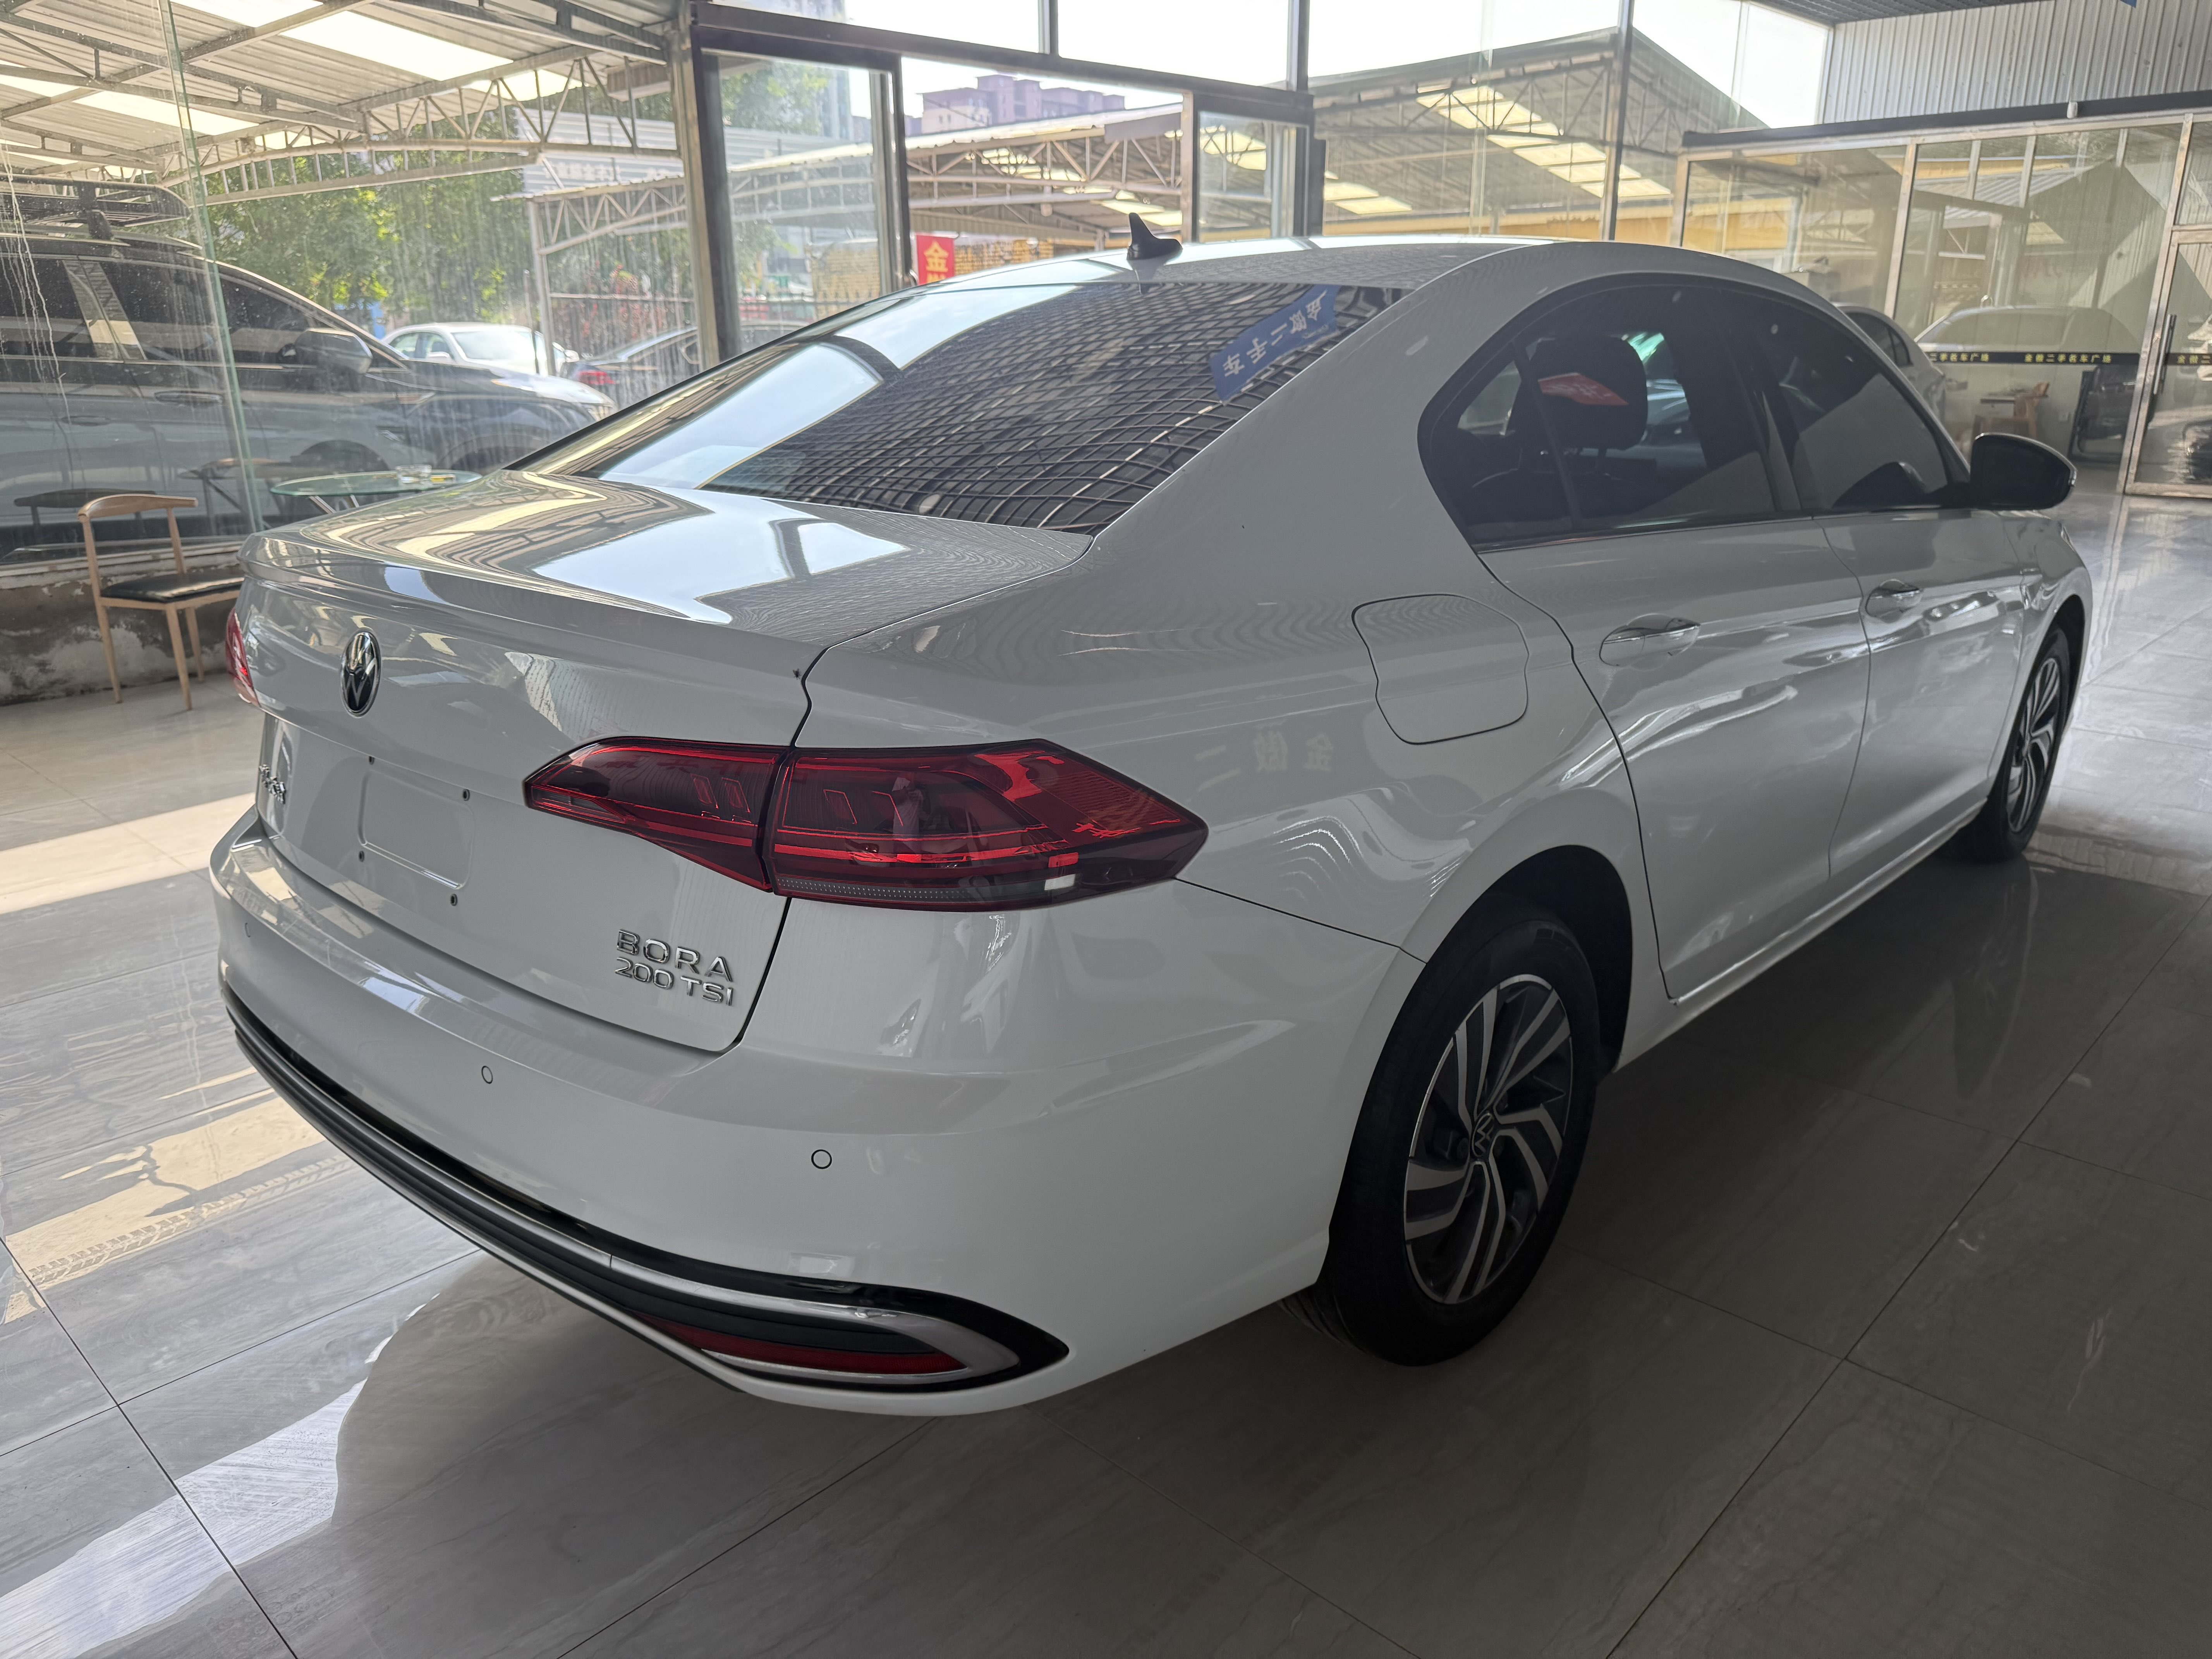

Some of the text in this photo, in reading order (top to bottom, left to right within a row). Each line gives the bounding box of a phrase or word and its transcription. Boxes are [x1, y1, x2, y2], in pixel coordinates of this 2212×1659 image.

[923, 240, 949, 283] 金
[617, 929, 733, 982] BORA
[615, 957, 733, 1006] 200 TSI
